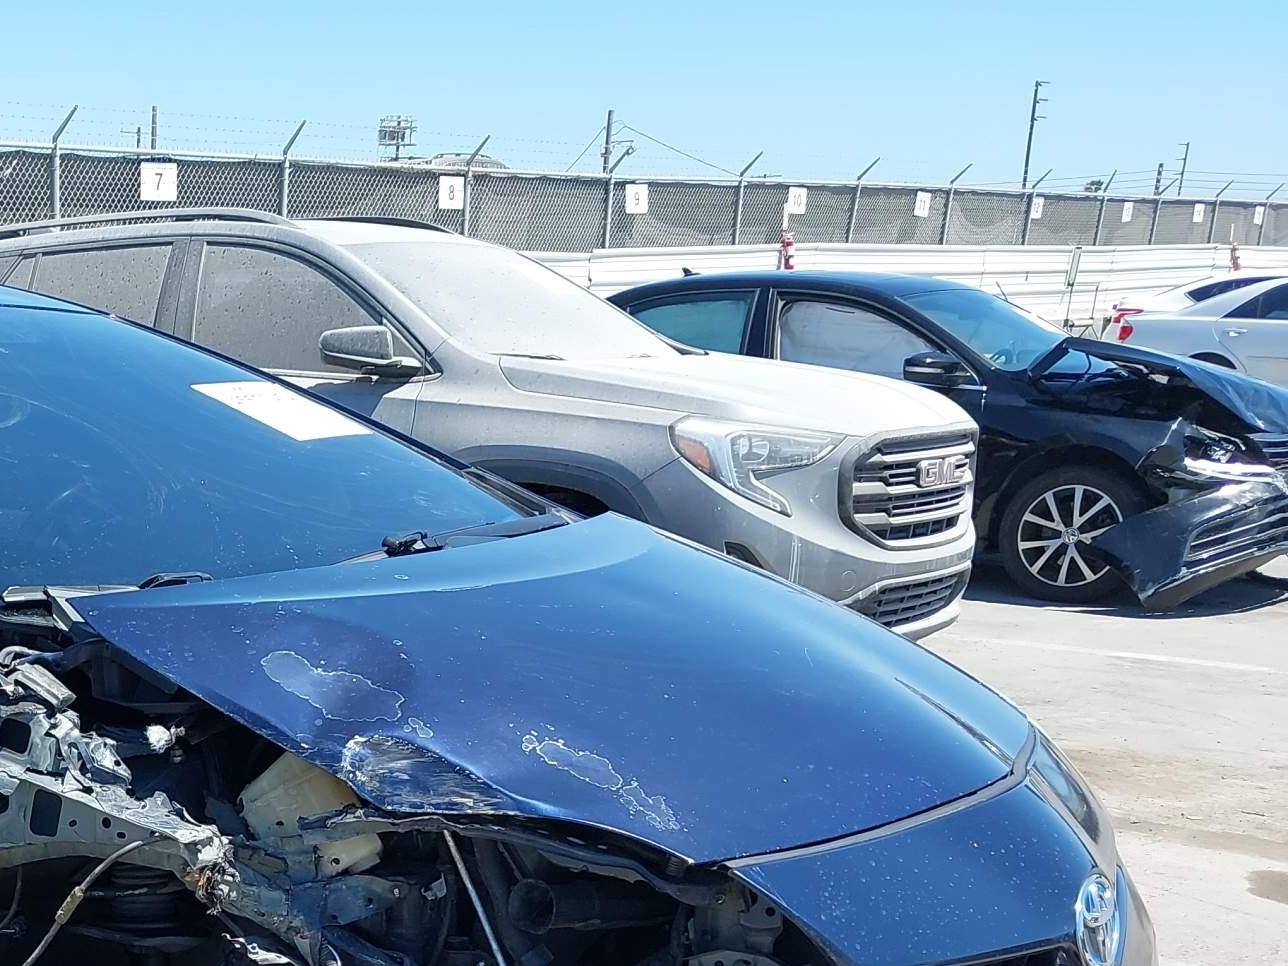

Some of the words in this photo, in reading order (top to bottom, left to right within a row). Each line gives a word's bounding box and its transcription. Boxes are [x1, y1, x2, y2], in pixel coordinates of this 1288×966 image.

[154, 173, 163, 191] 7
[448, 185, 456, 201] 8
[633, 191, 640, 206] 9
[793, 194, 802, 207] 10
[920, 456, 965, 486] GMC
